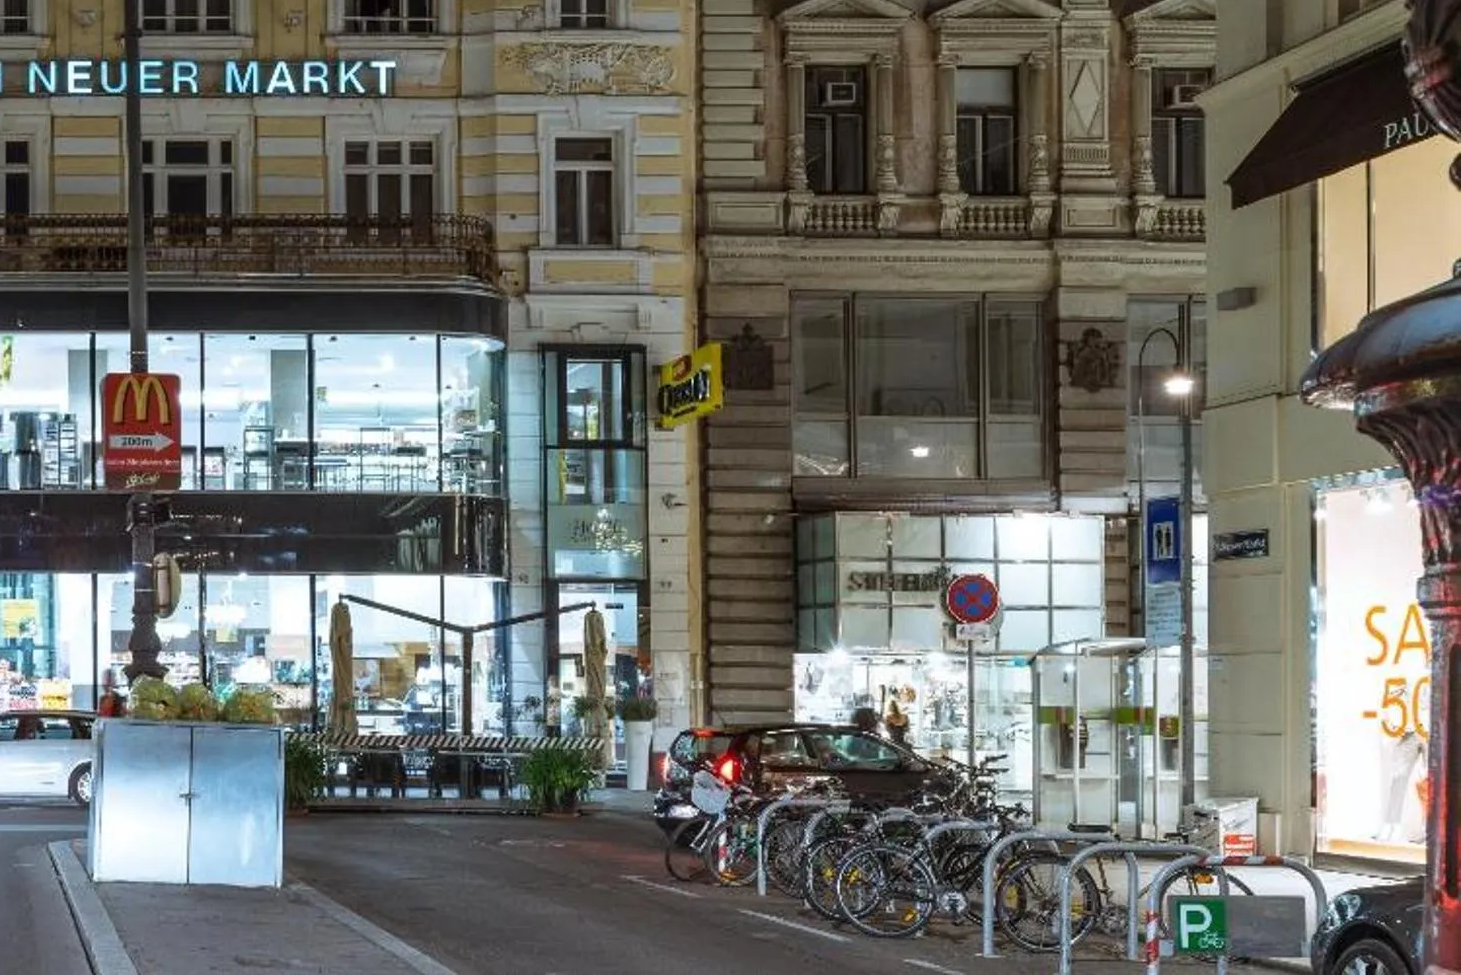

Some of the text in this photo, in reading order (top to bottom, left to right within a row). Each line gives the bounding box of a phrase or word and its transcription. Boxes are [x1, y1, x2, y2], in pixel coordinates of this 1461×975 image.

[28, 61, 199, 94] NEUER
[225, 61, 396, 94] MARKT
[1384, 113, 1440, 148] PAU
[1365, 604, 1431, 666] SA
[1180, 904, 1213, 949] P
